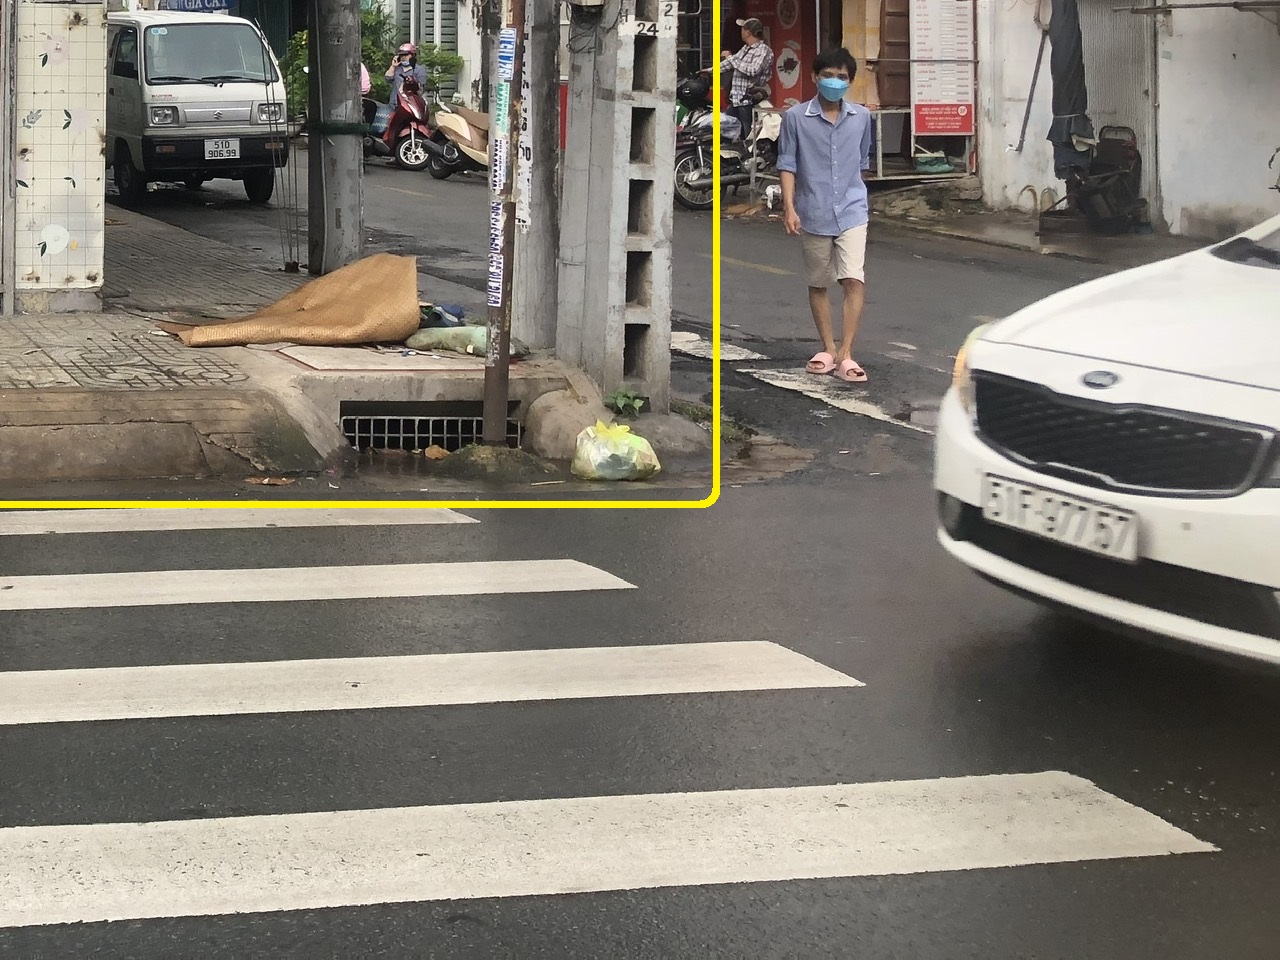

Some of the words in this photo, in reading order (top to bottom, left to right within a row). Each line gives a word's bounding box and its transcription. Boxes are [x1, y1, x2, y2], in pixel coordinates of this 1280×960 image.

[664, 3, 674, 17] 2
[637, 22, 659, 36] 24
[214, 140, 230, 149] 51D
[208, 149, 237, 158] 906.99
